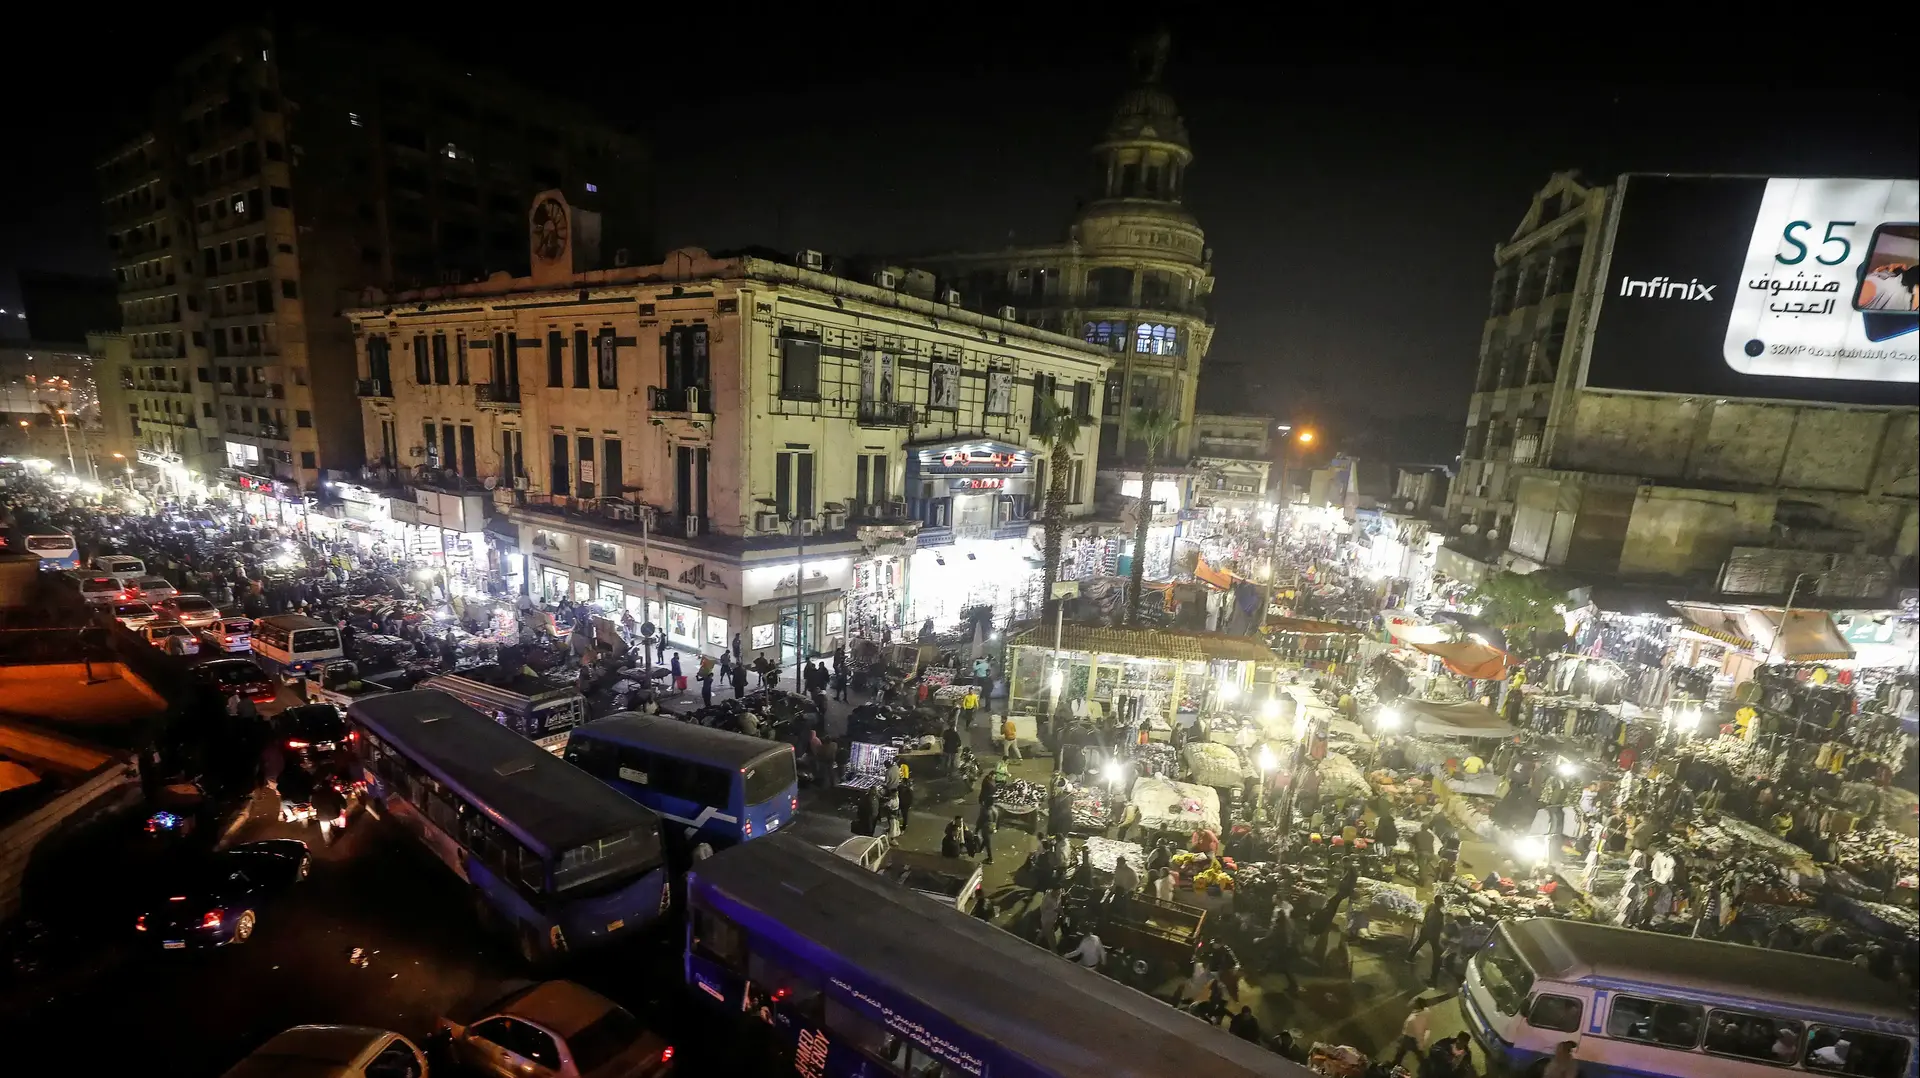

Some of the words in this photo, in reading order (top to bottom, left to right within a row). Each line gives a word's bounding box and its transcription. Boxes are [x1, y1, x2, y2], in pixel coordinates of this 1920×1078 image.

[1775, 220, 1856, 266] S5
[1619, 276, 1717, 301] Infinix
[1749, 272, 1841, 296] هتشوف
[1770, 299, 1836, 319] العجب
[1770, 343, 1807, 356] 32MP
[633, 562, 669, 580] Haawa
